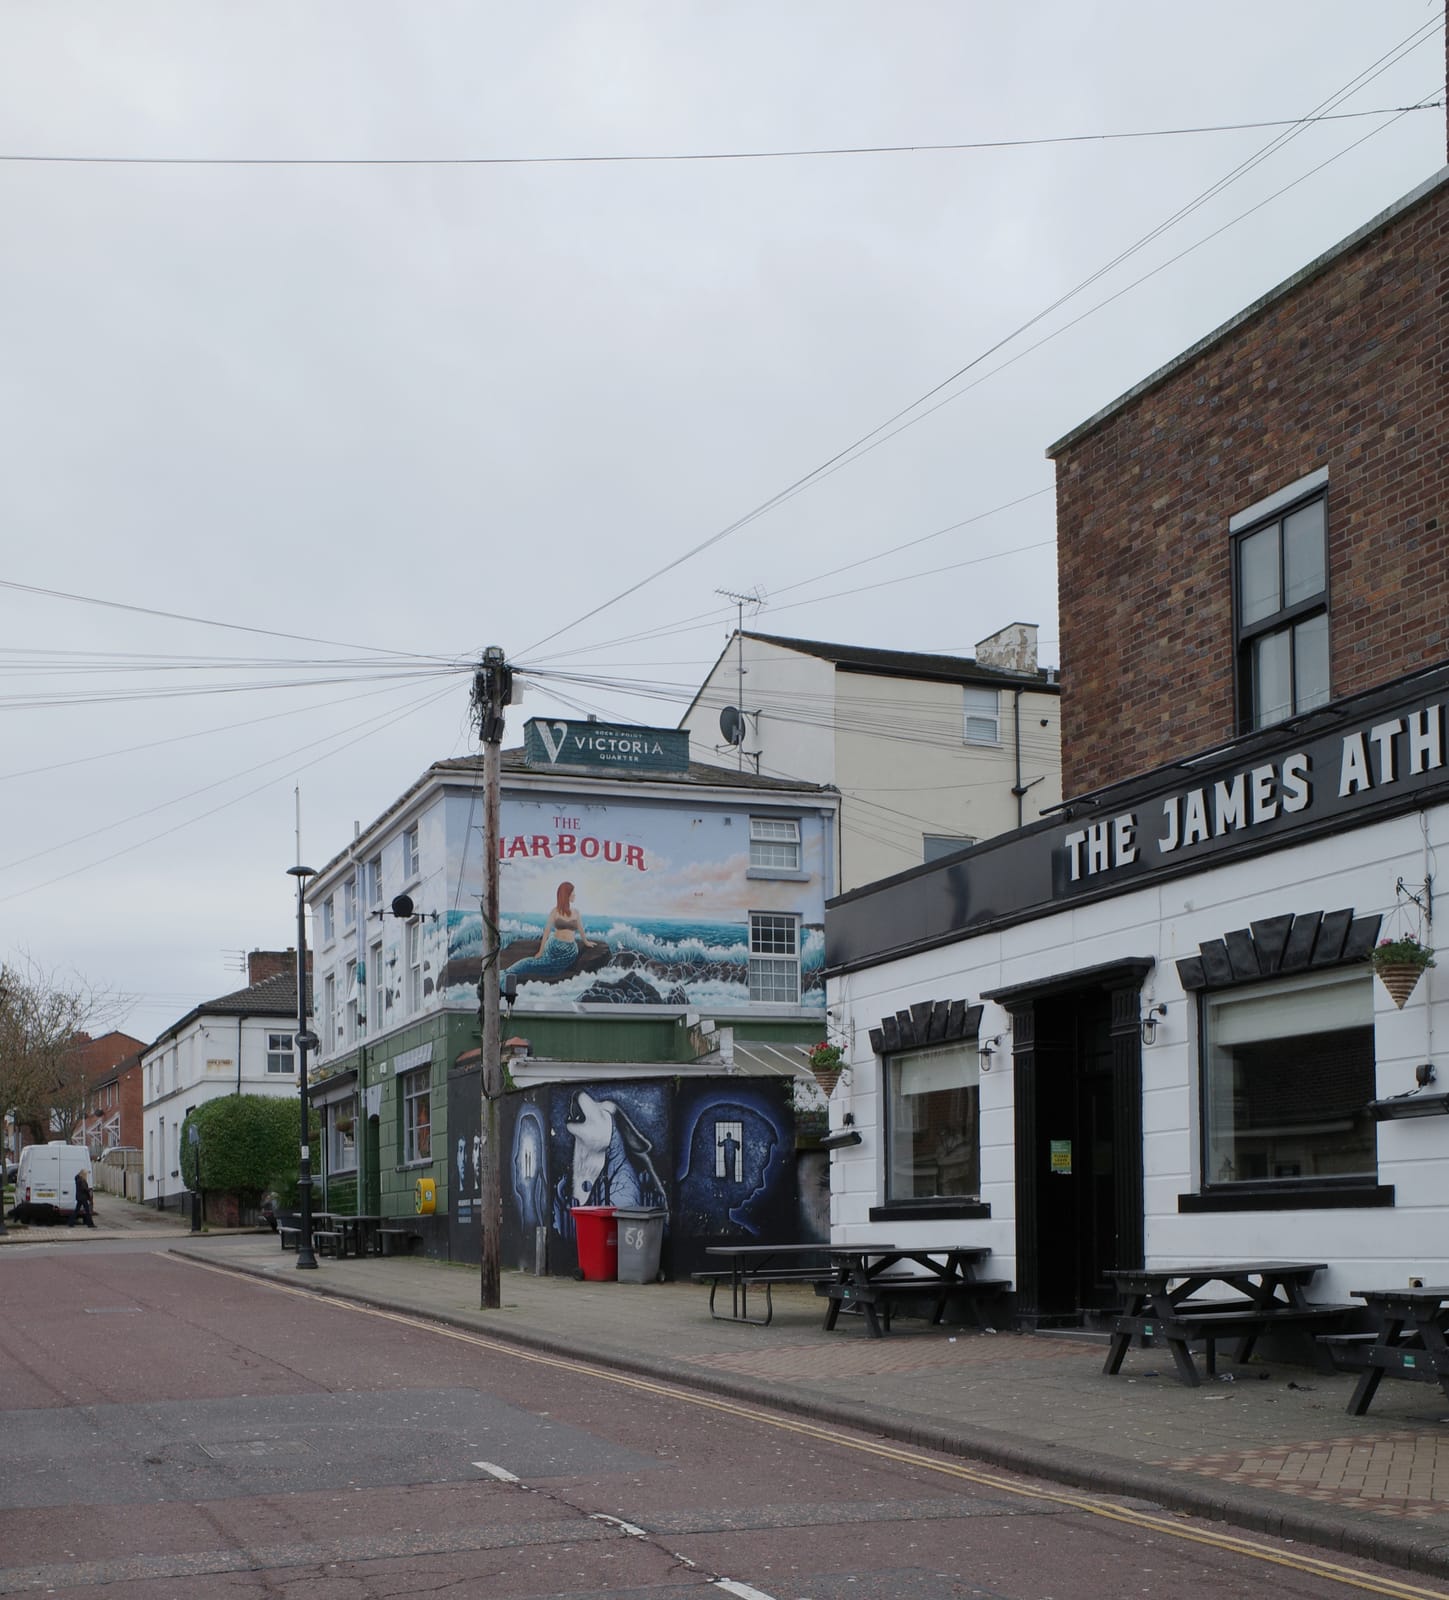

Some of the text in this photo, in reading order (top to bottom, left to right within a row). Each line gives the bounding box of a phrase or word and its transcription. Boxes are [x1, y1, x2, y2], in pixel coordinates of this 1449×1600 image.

[574, 736, 664, 755] VICTORIA
[600, 753, 639, 763] QUARTER
[553, 816, 581, 830] THE
[1065, 813, 1136, 880] THE
[1158, 753, 1309, 853] JAMES
